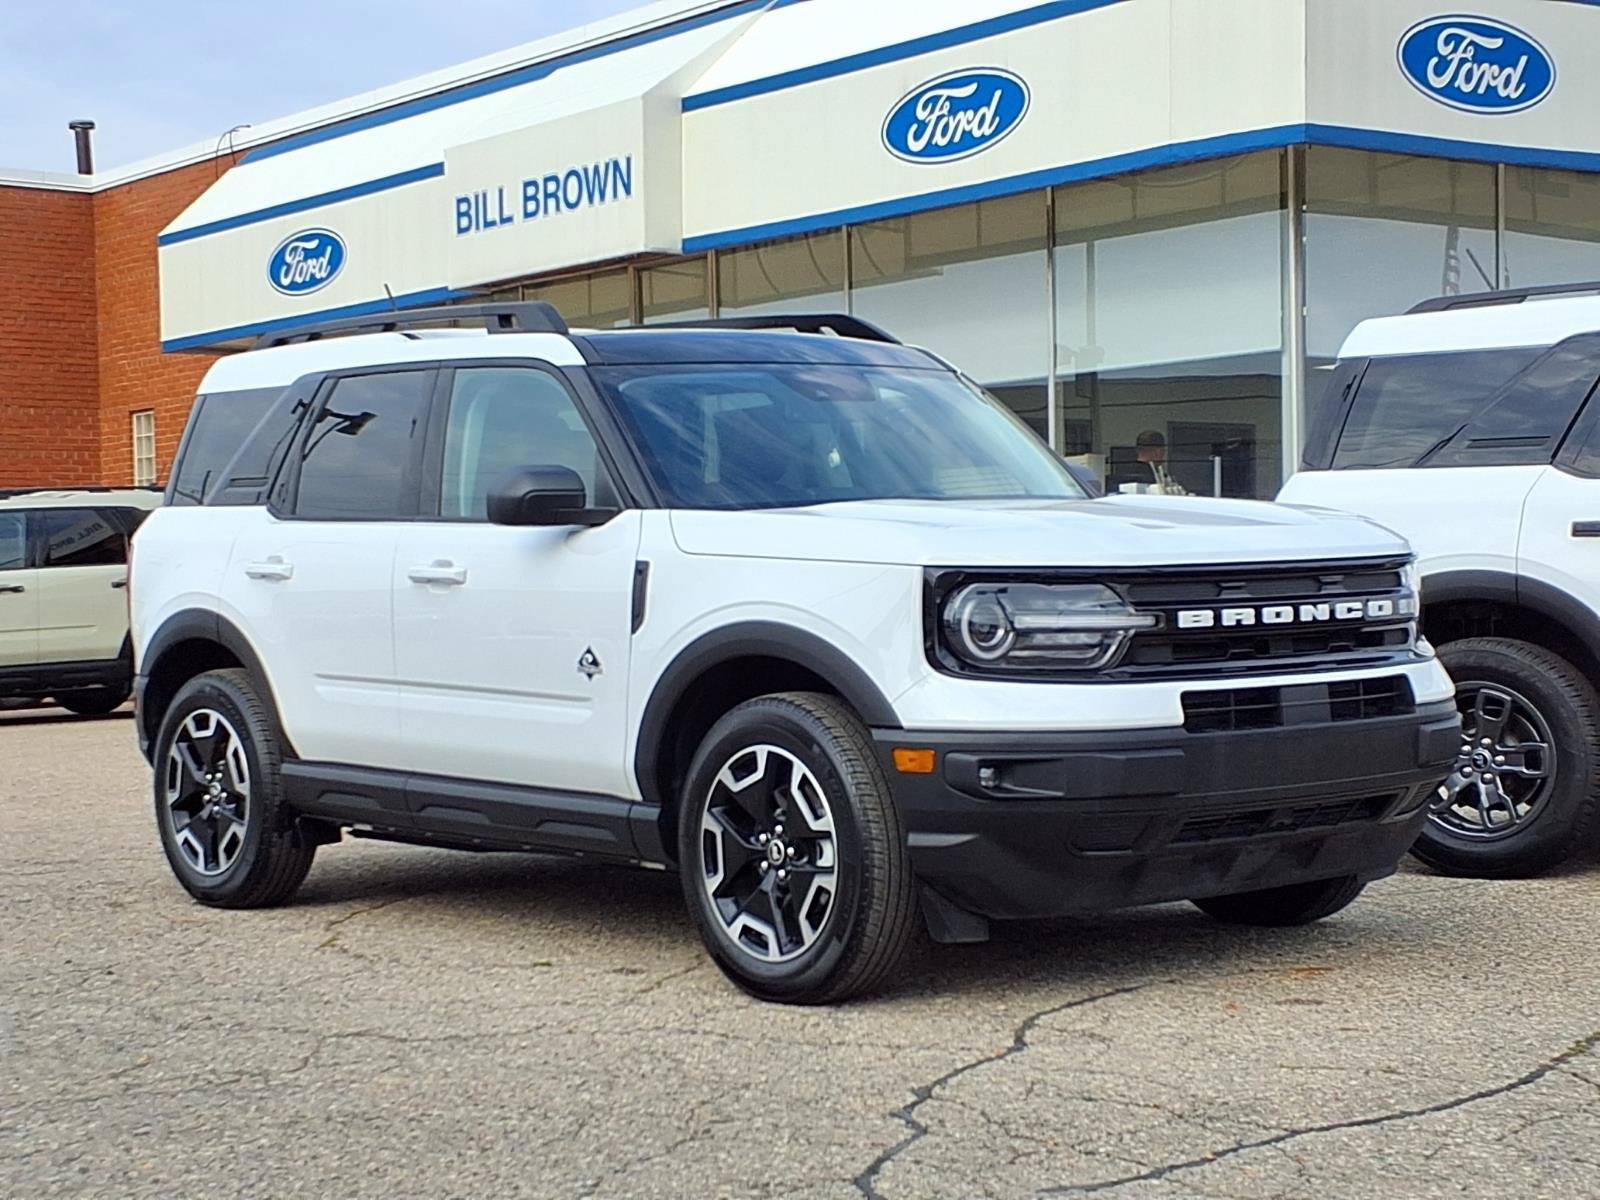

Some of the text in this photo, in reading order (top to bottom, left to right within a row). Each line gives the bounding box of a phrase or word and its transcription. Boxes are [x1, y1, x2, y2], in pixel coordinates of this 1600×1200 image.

[1426, 27, 1529, 99] Ford
[907, 82, 1003, 152] Ford
[455, 156, 633, 235] BILL BROWN
[280, 238, 332, 287] Ford
[1176, 600, 1393, 629] BRONCO
